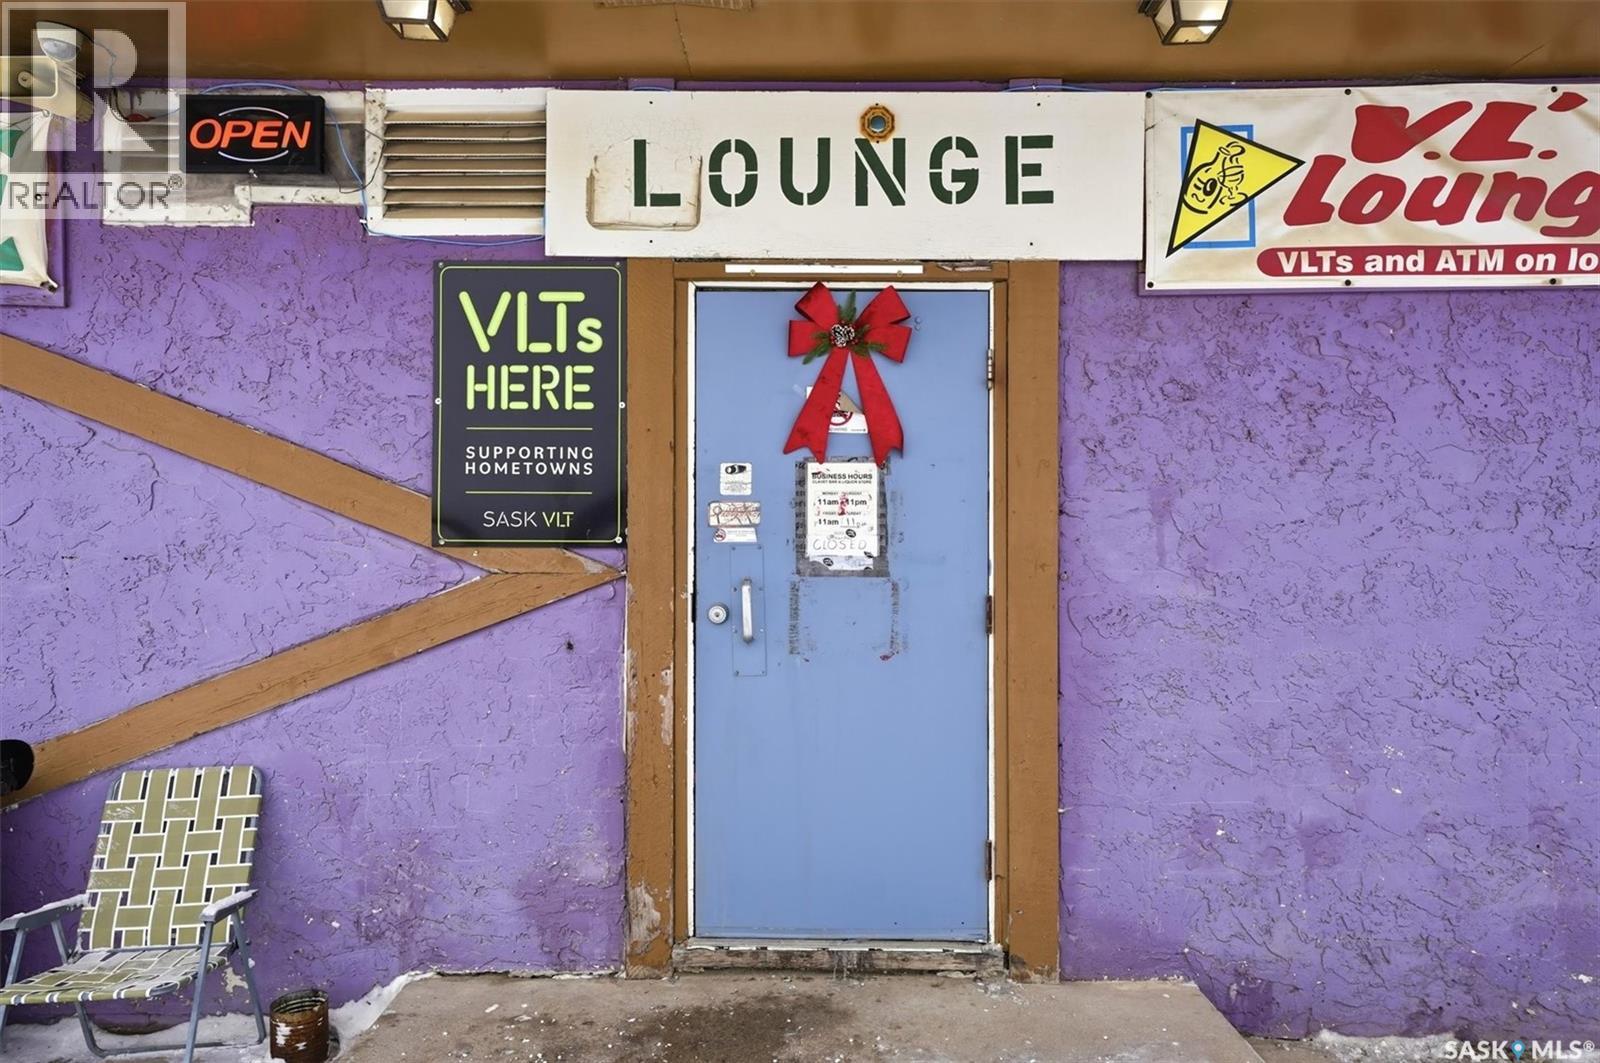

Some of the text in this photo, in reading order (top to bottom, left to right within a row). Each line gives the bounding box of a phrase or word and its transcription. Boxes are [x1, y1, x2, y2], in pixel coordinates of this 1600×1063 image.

[190, 119, 311, 150] OPEN
[633, 135, 1054, 208] LOUNGE
[1283, 154, 1600, 237] Loung
[1277, 250, 1353, 274] VLTs
[1364, 249, 1425, 273] and
[1435, 249, 1504, 272] ATM
[1515, 252, 1557, 272] on
[458, 290, 603, 353] VLTs
[466, 364, 595, 411] HERE
[465, 446, 593, 460] SUPPORTING
[465, 462, 593, 475] HOMETOWNS
[482, 510, 575, 528] SASK VLT
[812, 538, 867, 551] CLOSED
